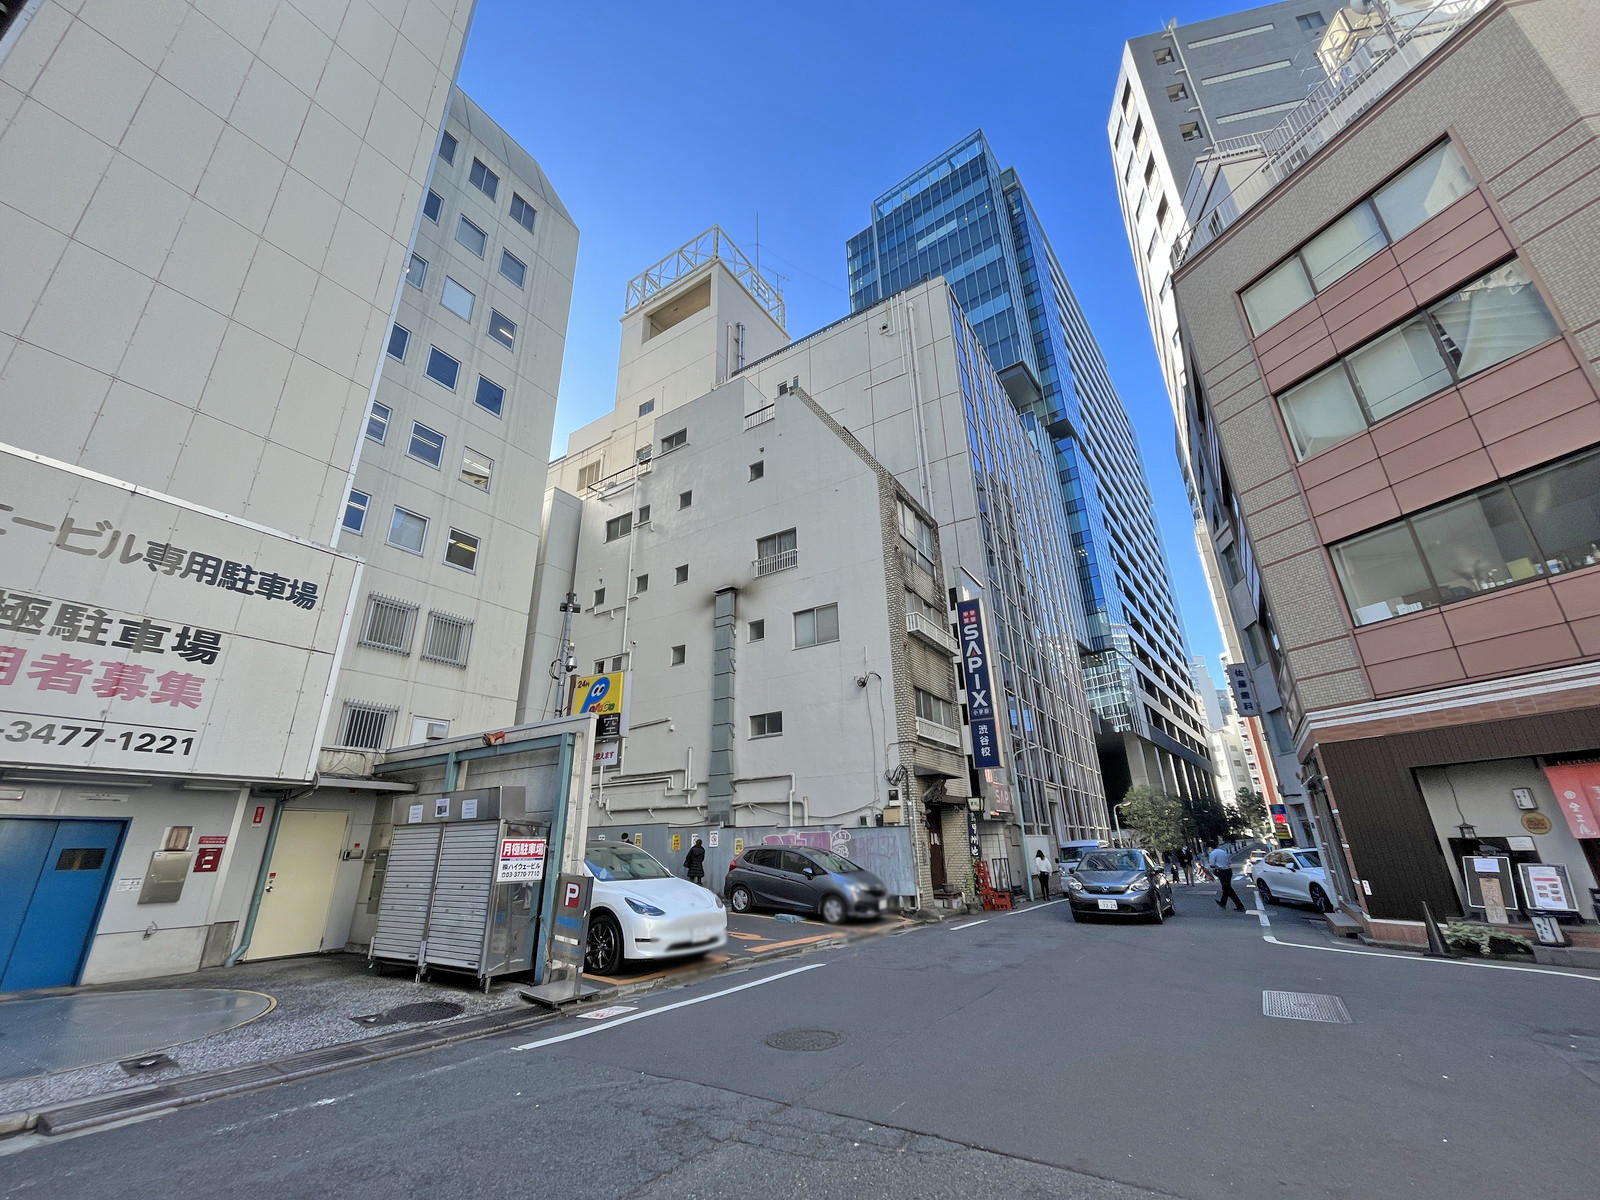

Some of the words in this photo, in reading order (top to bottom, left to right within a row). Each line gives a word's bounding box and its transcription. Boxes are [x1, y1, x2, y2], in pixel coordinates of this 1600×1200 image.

[963, 623, 989, 708] SAPIX
[577, 680, 590, 689] 24H
[602, 714, 619, 735] 空
[978, 724, 992, 757] 渋谷校
[503, 842, 545, 857] 月極駐車場
[564, 882, 580, 906] P
